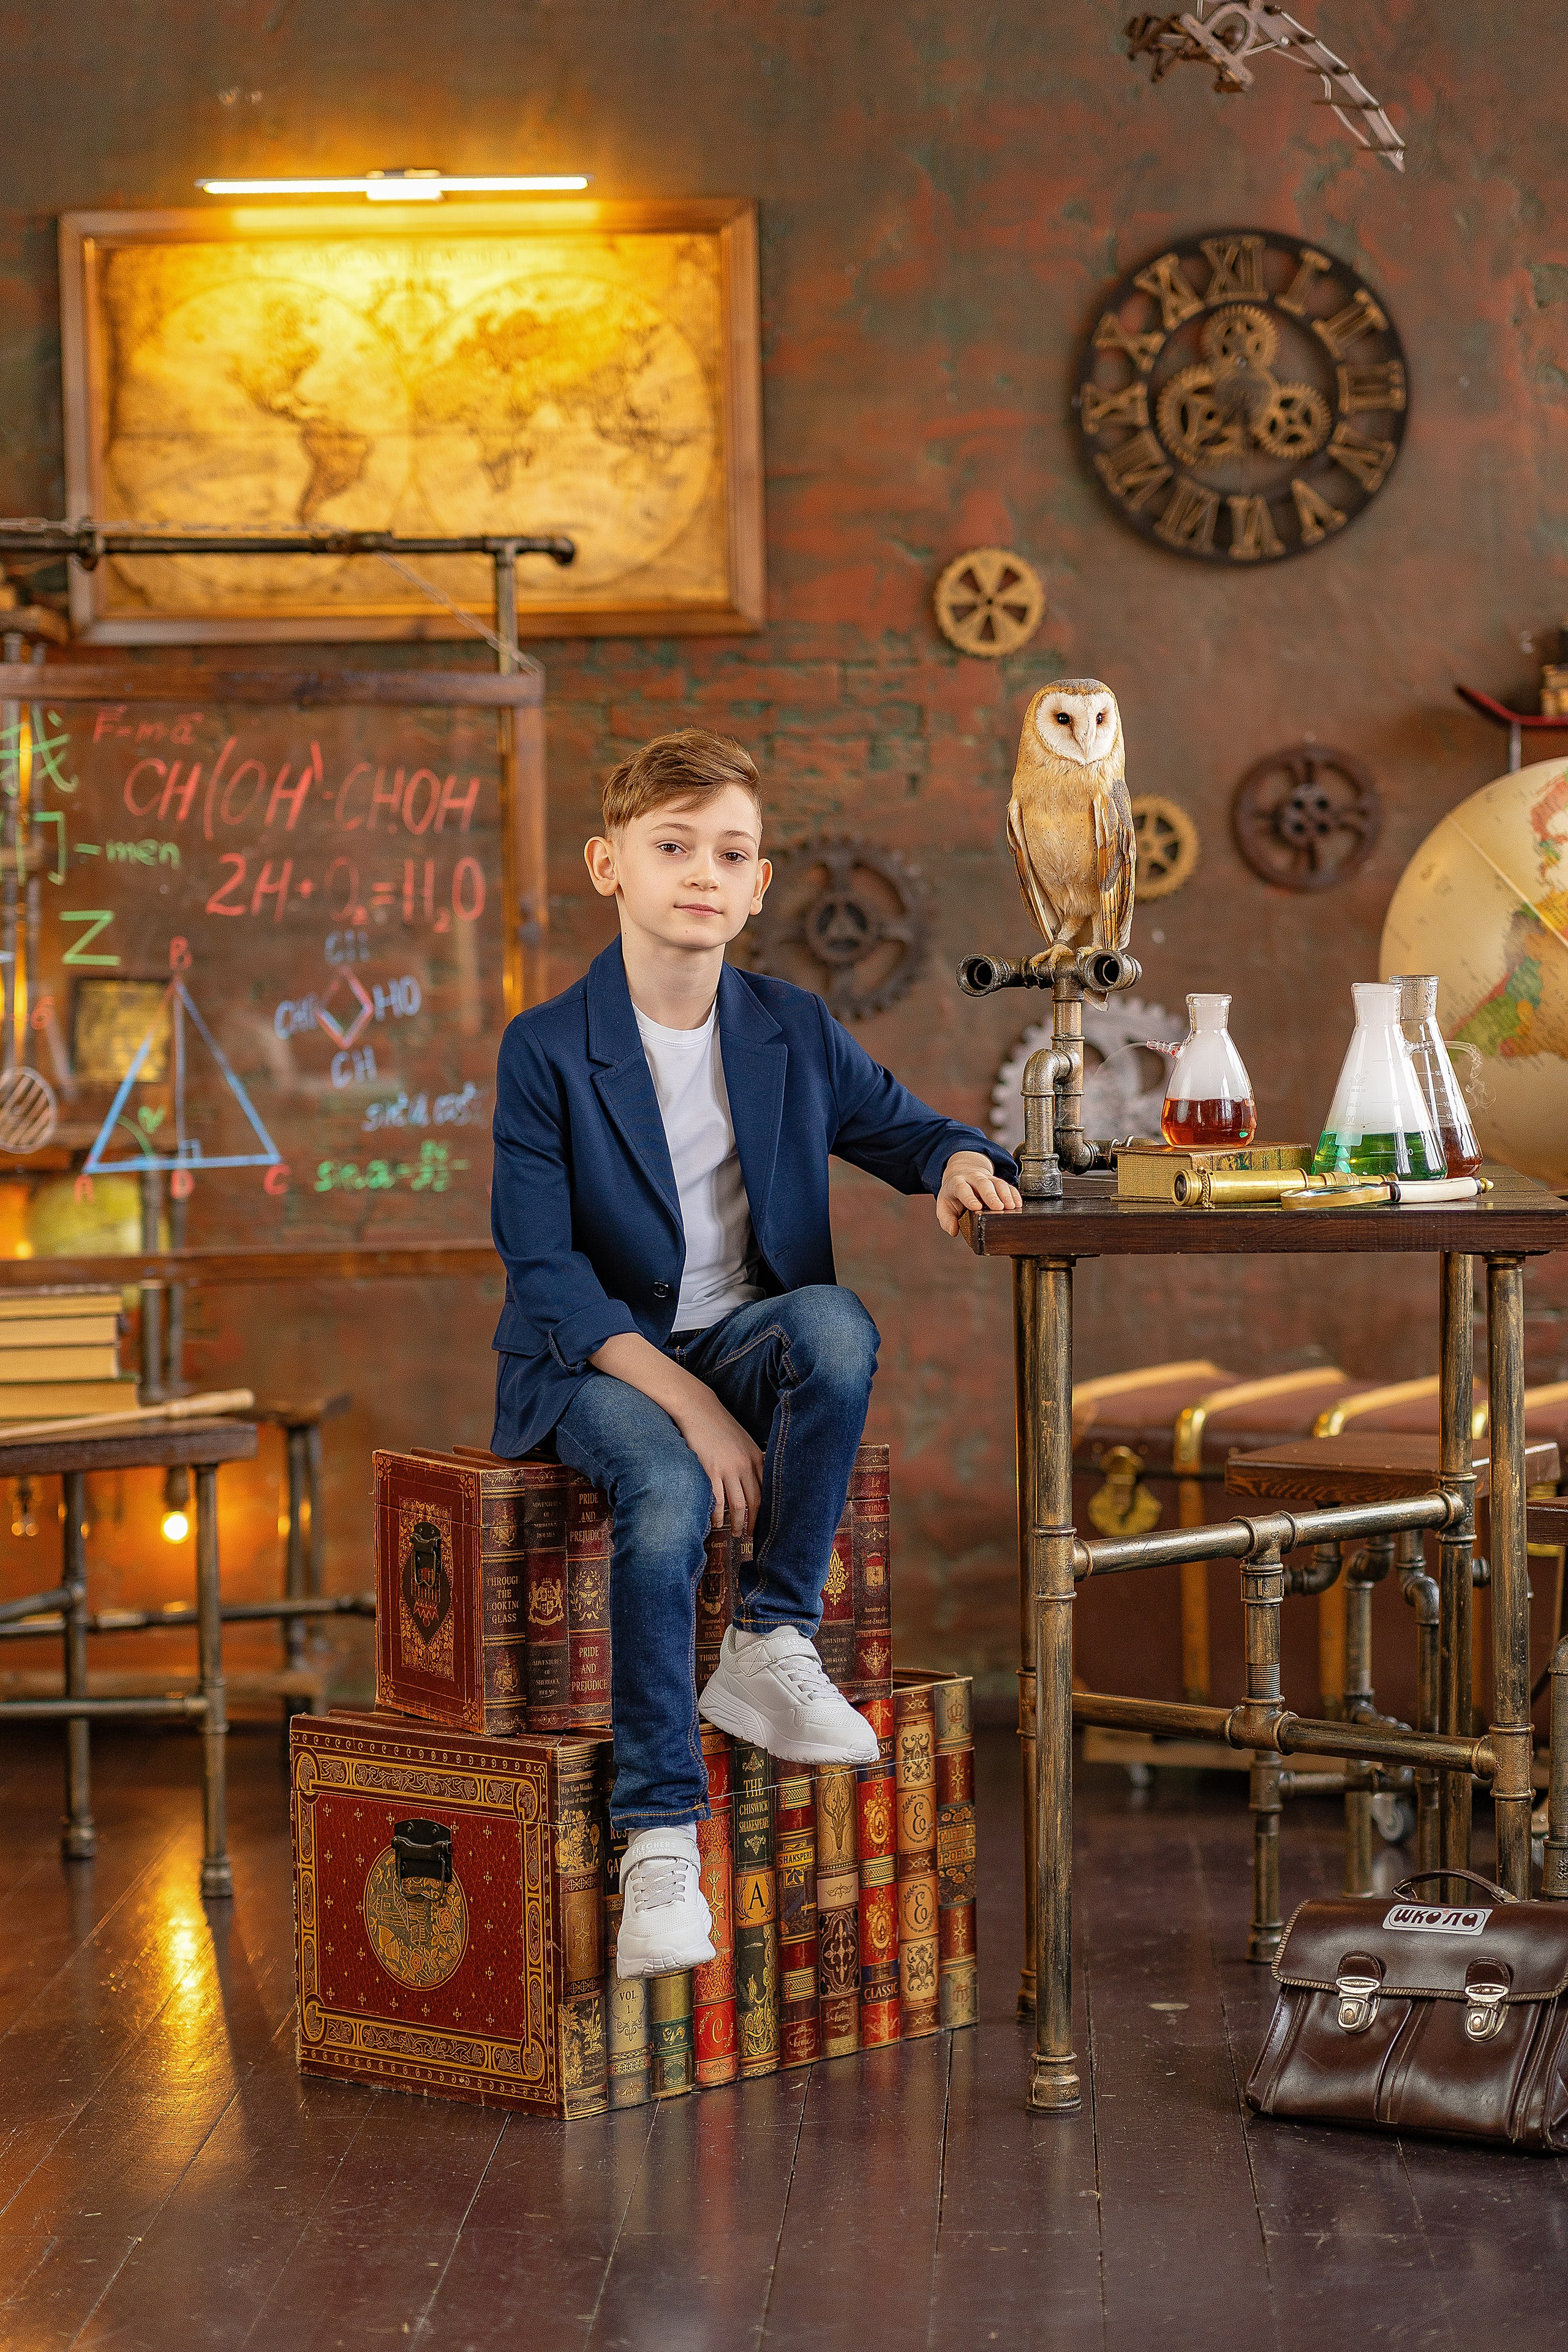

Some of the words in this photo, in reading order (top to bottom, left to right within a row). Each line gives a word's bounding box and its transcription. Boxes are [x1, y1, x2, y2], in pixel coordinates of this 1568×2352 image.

[579, 1492, 598, 1505] PRIDE
[581, 1511, 596, 1523] AND
[570, 1529, 605, 1543] PREJUDICE
[496, 1589, 512, 1599] THE
[492, 1613, 517, 1624] GLASS
[579, 1646, 599, 1657] PRIDE
[581, 1663, 597, 1675] AND
[571, 1679, 608, 1694] PREJUDICE
[560, 1787, 570, 1795] Rip
[743, 1777, 764, 1799] THE
[739, 1800, 769, 1816] CHISWICK
[739, 1816, 769, 1834] SHAKESPEARE
[632, 1841, 676, 1856] SKECHERS
[778, 1850, 813, 1865] SHAKSPERE
[747, 1880, 766, 1910] A
[619, 1990, 639, 2002] VOL.
[864, 1982, 899, 2000] CLASSIC
[712, 2018, 724, 2043] C
